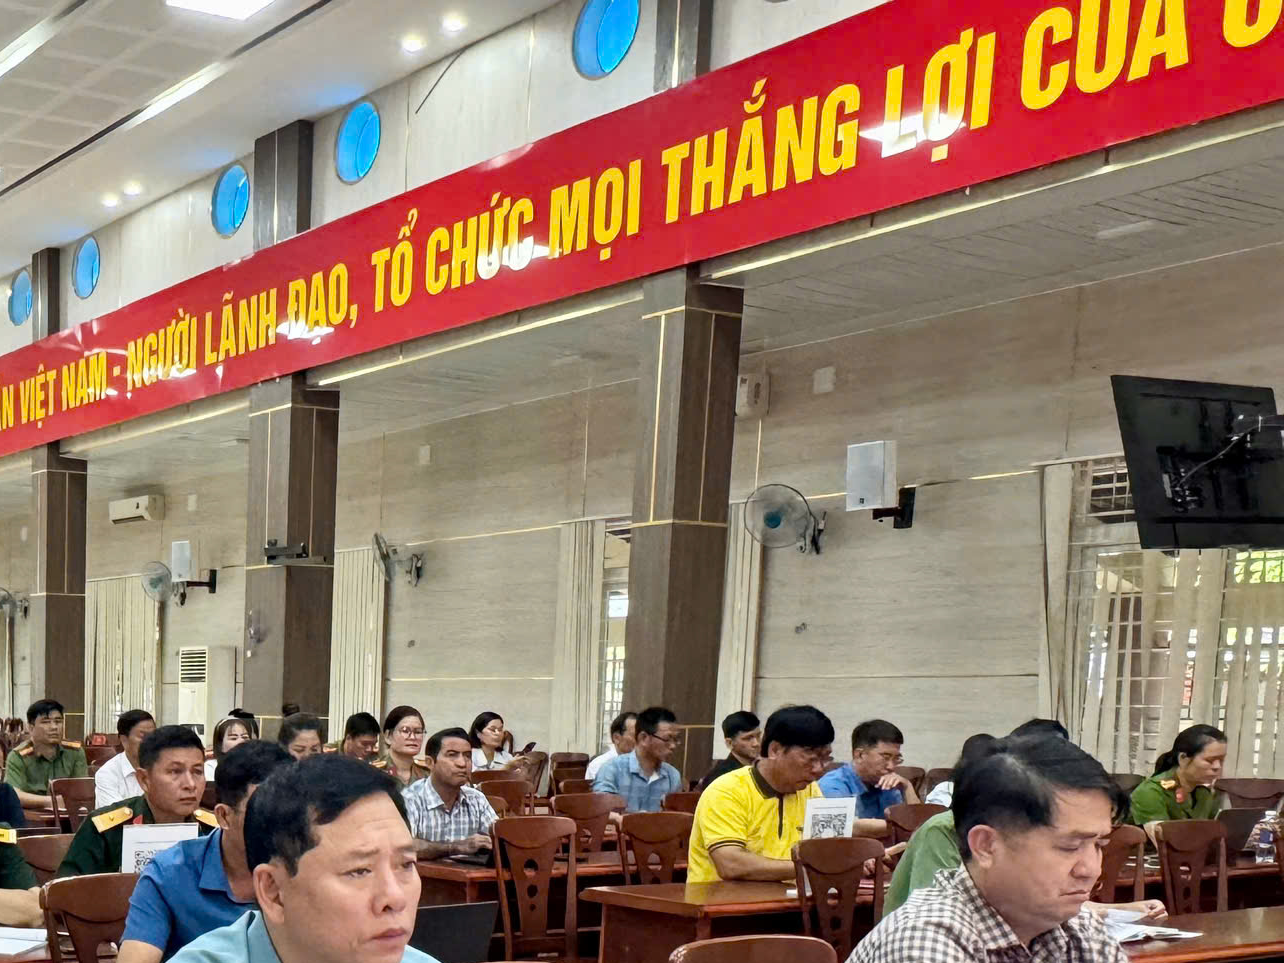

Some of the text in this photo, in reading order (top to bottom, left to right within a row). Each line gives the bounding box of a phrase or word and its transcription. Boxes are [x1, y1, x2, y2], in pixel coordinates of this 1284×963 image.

[20, 363, 57, 429] VIỆT
[61, 351, 107, 412] NAM
[127, 308, 198, 391] NGƯỜI
[205, 290, 277, 365] LÃNH
[286, 263, 358, 345] ĐẠO,
[372, 207, 418, 313] TỔ
[425, 191, 534, 295] CHỨC
[548, 159, 642, 261] MỌI
[661, 77, 861, 224] THẮNG
[881, 27, 996, 163] LỢI
